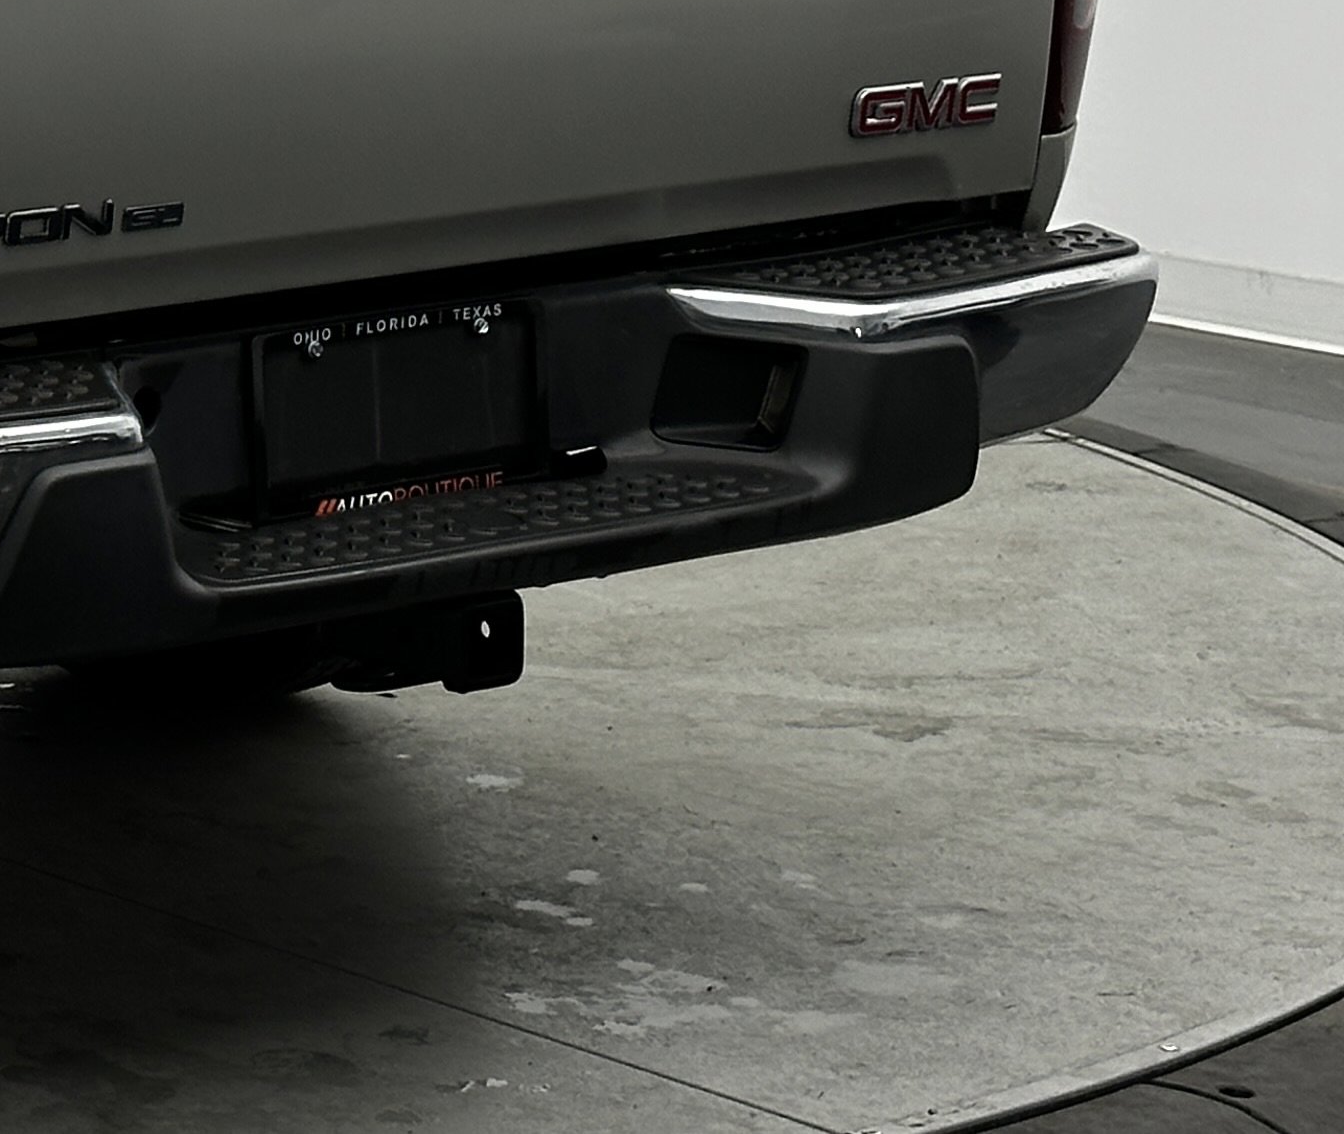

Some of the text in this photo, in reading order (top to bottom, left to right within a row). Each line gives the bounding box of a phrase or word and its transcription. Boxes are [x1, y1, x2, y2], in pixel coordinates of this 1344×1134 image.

[849, 72, 1002, 137] GMC
[355, 313, 429, 336] FLORIDA
[453, 303, 502, 321] TEXAS
